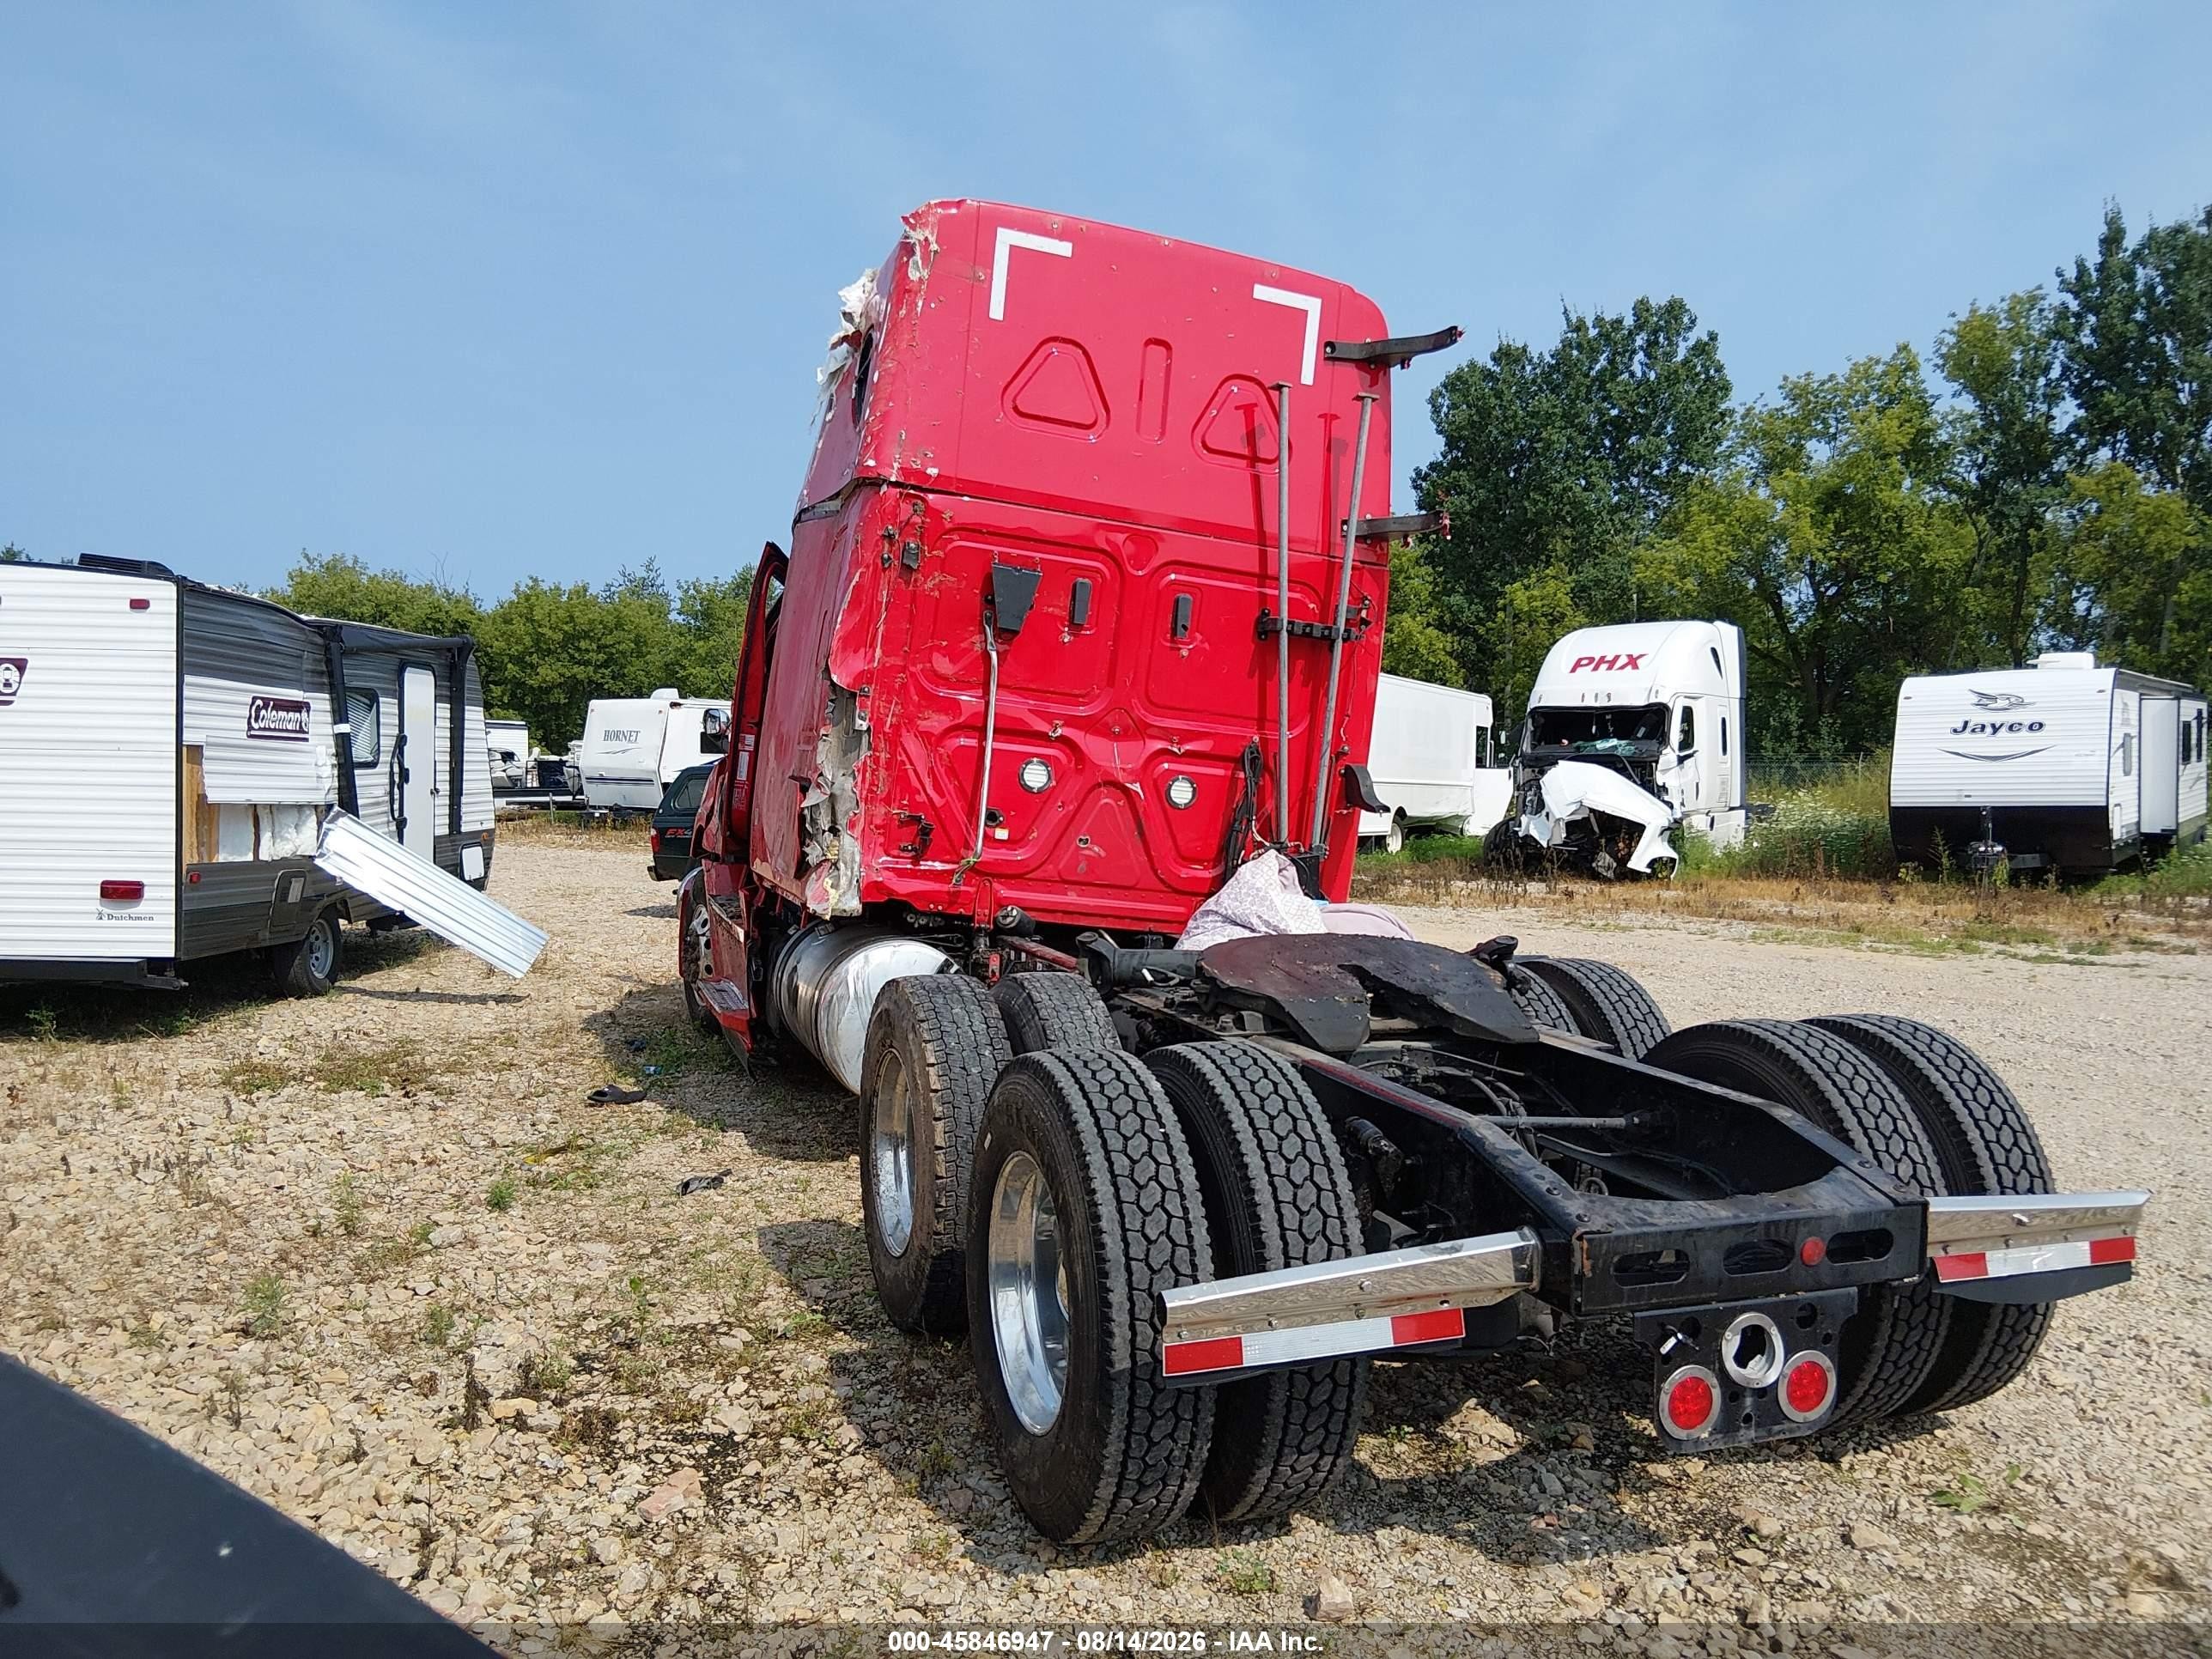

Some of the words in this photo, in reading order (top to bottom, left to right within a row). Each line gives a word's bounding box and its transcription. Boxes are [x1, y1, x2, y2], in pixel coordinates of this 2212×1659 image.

[1569, 653, 1649, 673] PHX
[251, 699, 301, 730] Coleman
[603, 729, 641, 742] HORNET
[1950, 719, 2046, 737] Jayco
[106, 913, 155, 921] Dutchmen
